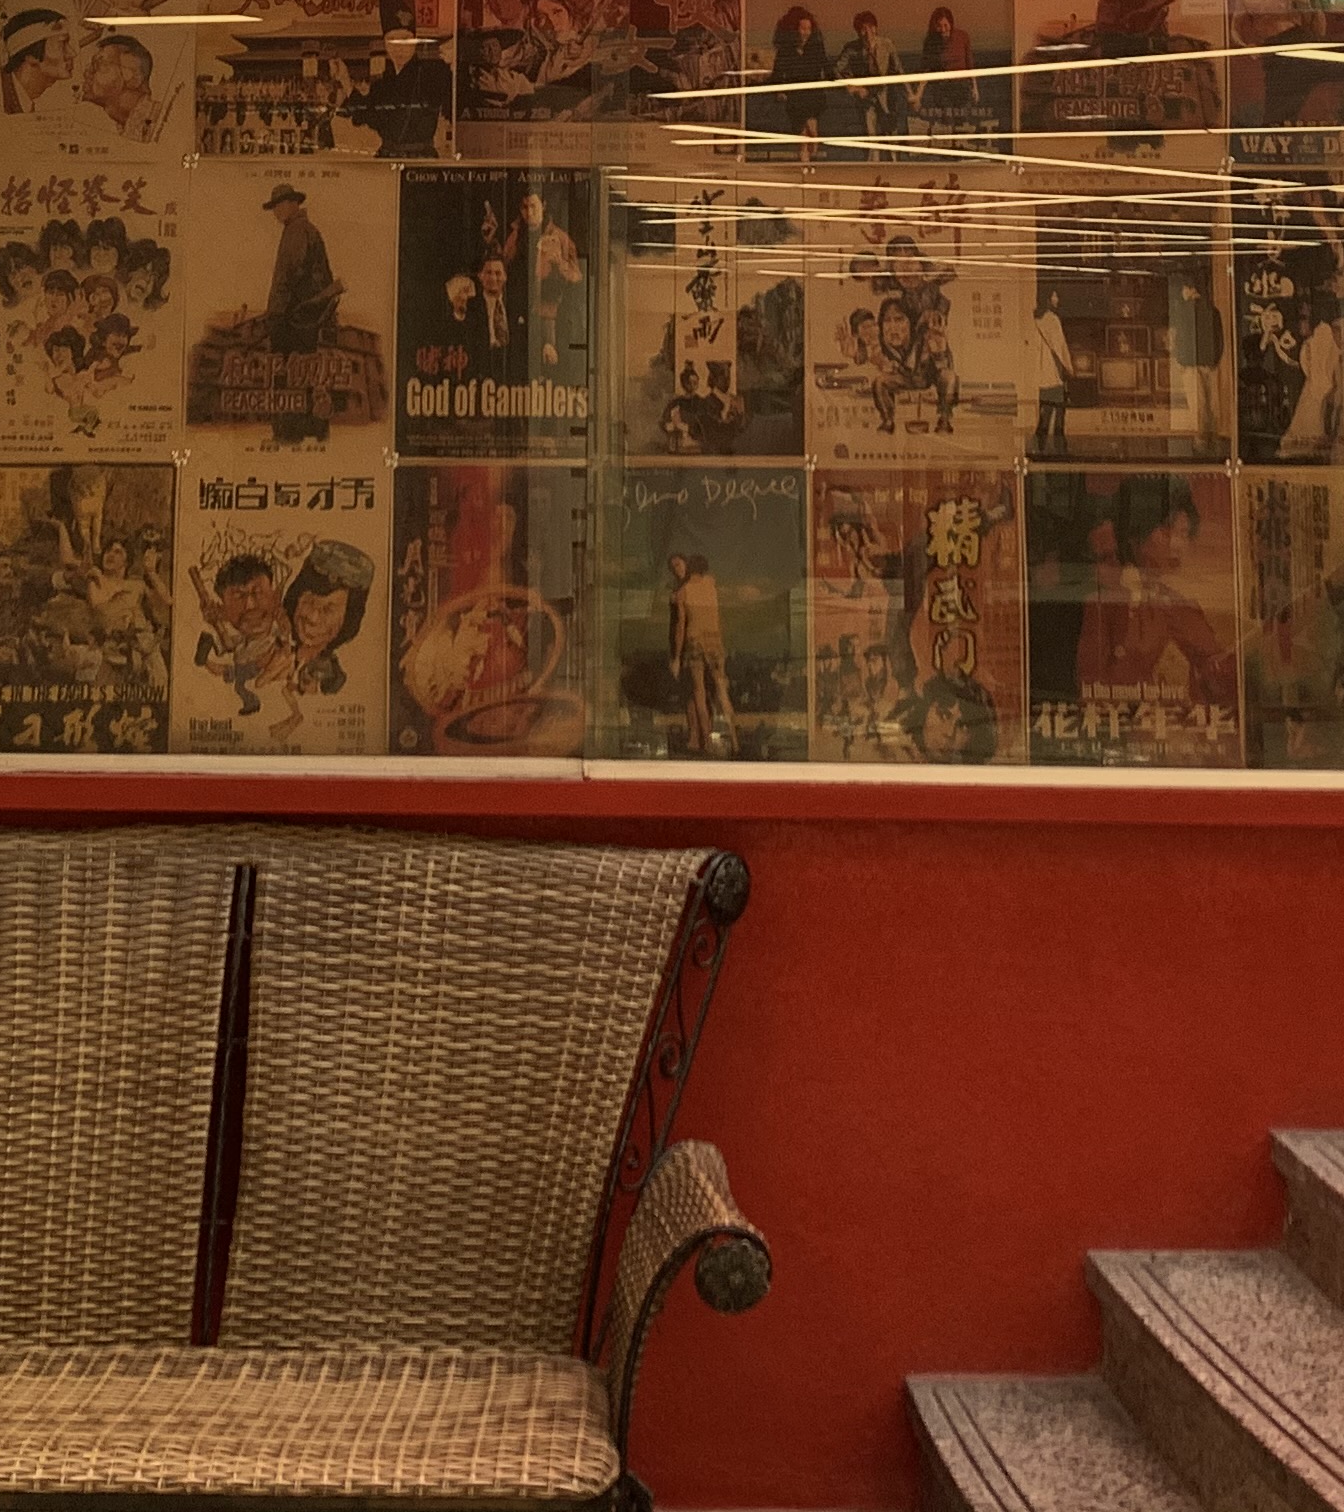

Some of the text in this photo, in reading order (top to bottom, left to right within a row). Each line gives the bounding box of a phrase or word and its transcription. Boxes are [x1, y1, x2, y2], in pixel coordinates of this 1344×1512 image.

[1240, 133, 1293, 155] WAY
[407, 376, 588, 418] God of Gamblers
